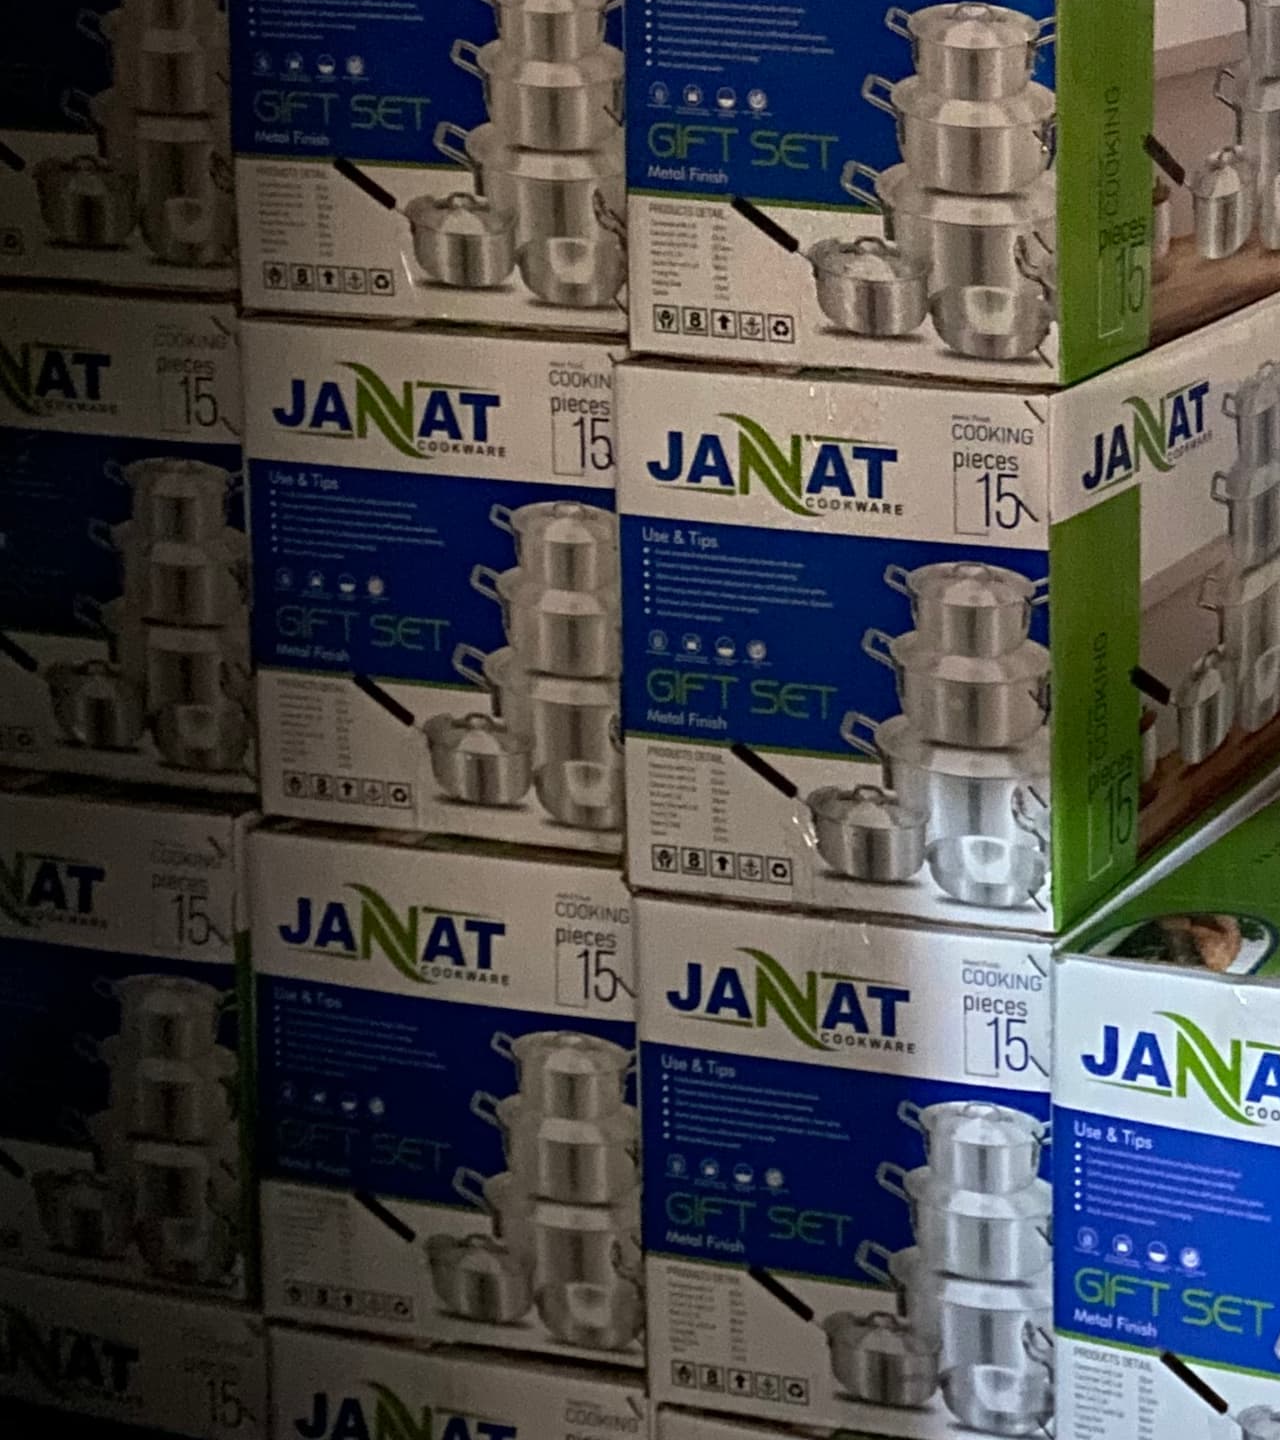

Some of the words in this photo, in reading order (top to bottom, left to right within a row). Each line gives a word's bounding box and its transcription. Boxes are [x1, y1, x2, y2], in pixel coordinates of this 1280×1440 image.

[648, 164, 687, 182] Metal
[690, 168, 729, 185] Finish
[178, 375, 216, 428] 15
[272, 360, 500, 458] JANAT
[1082, 382, 1210, 473] JANAT
[646, 411, 898, 515] JANAT
[645, 668, 740, 711] GIFT
[752, 679, 839, 722] SET
[276, 882, 505, 983] JANAT
[665, 946, 910, 1051] JANAT
[821, 1032, 916, 1055] COOKWARE
[987, 1015, 1028, 1073] 15
[1074, 1121, 1101, 1142] Use
[1106, 1127, 1117, 1143] &
[1123, 1130, 1153, 1152] Tips
[1073, 1266, 1170, 1318] GIFT
[1183, 1287, 1274, 1340] SET
[1074, 1307, 1113, 1329] Metal
[1117, 1316, 1157, 1338] Finish
